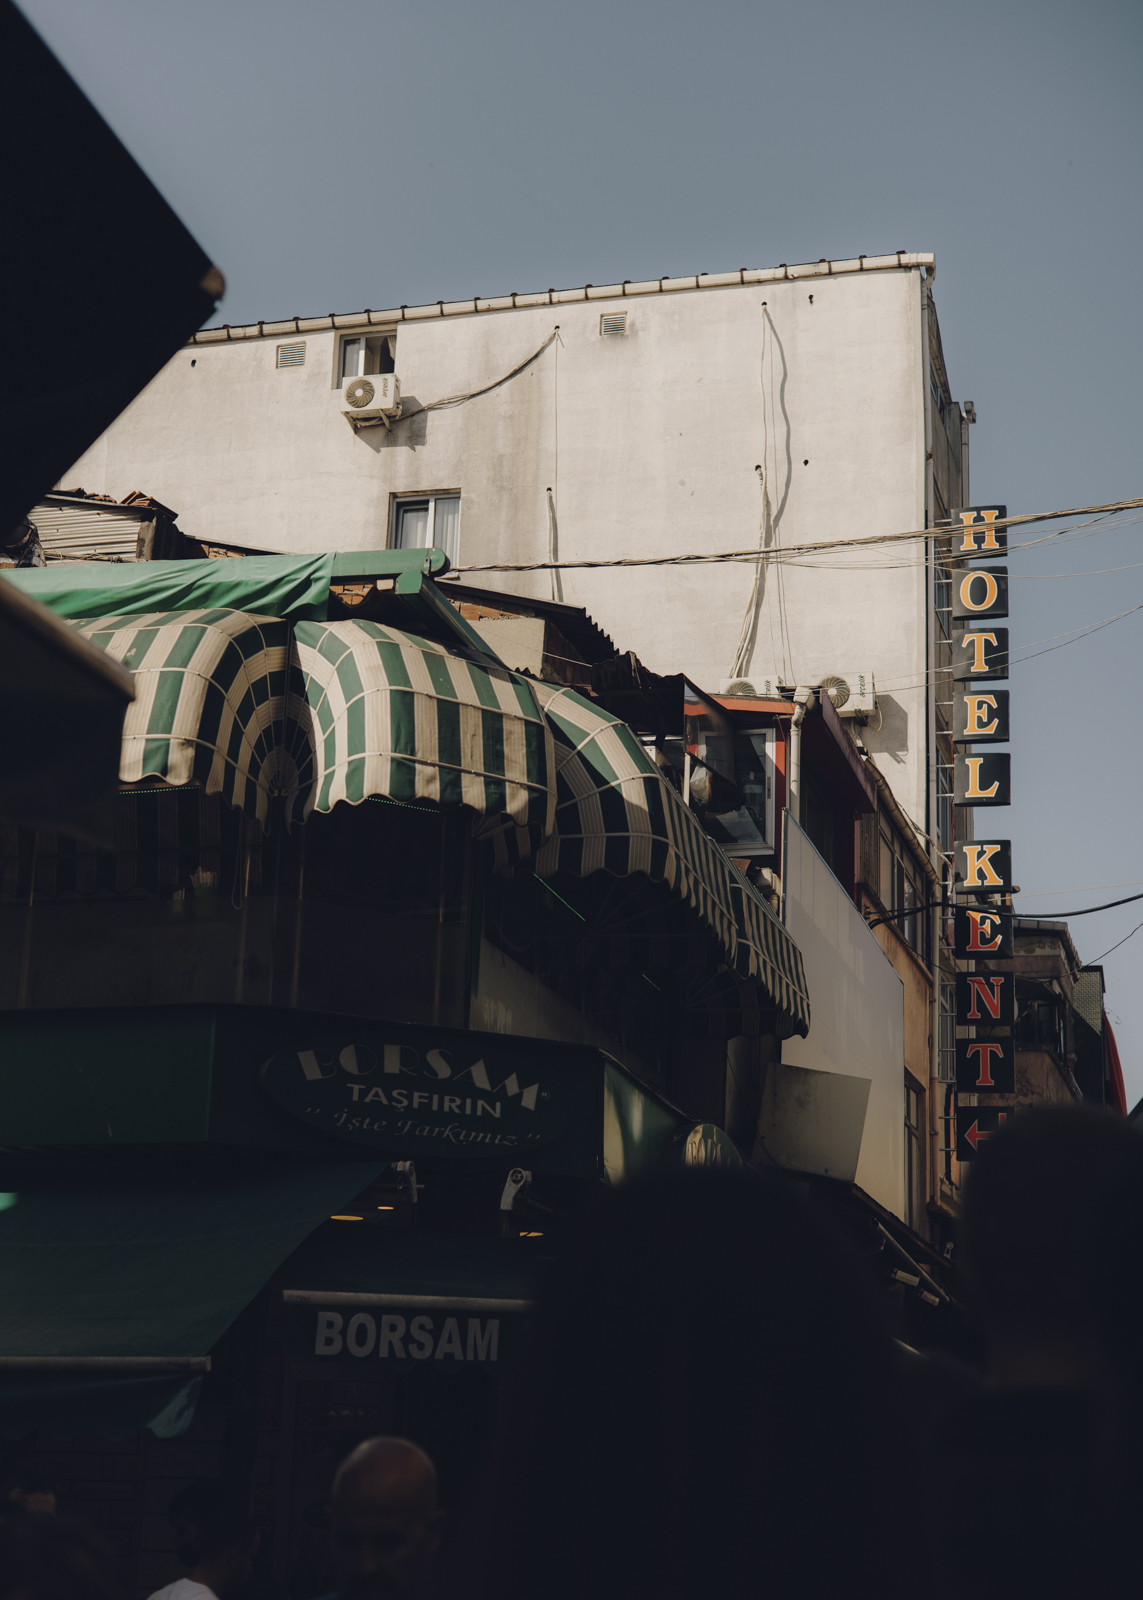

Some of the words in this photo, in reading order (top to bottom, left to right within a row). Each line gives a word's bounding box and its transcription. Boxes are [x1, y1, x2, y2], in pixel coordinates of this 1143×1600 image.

[959, 509, 1000, 798] HOTEL
[963, 845, 1004, 1087] KENT
[347, 1083, 501, 1119] TAŞFIRIN
[315, 1311, 500, 1362] BORSAM
